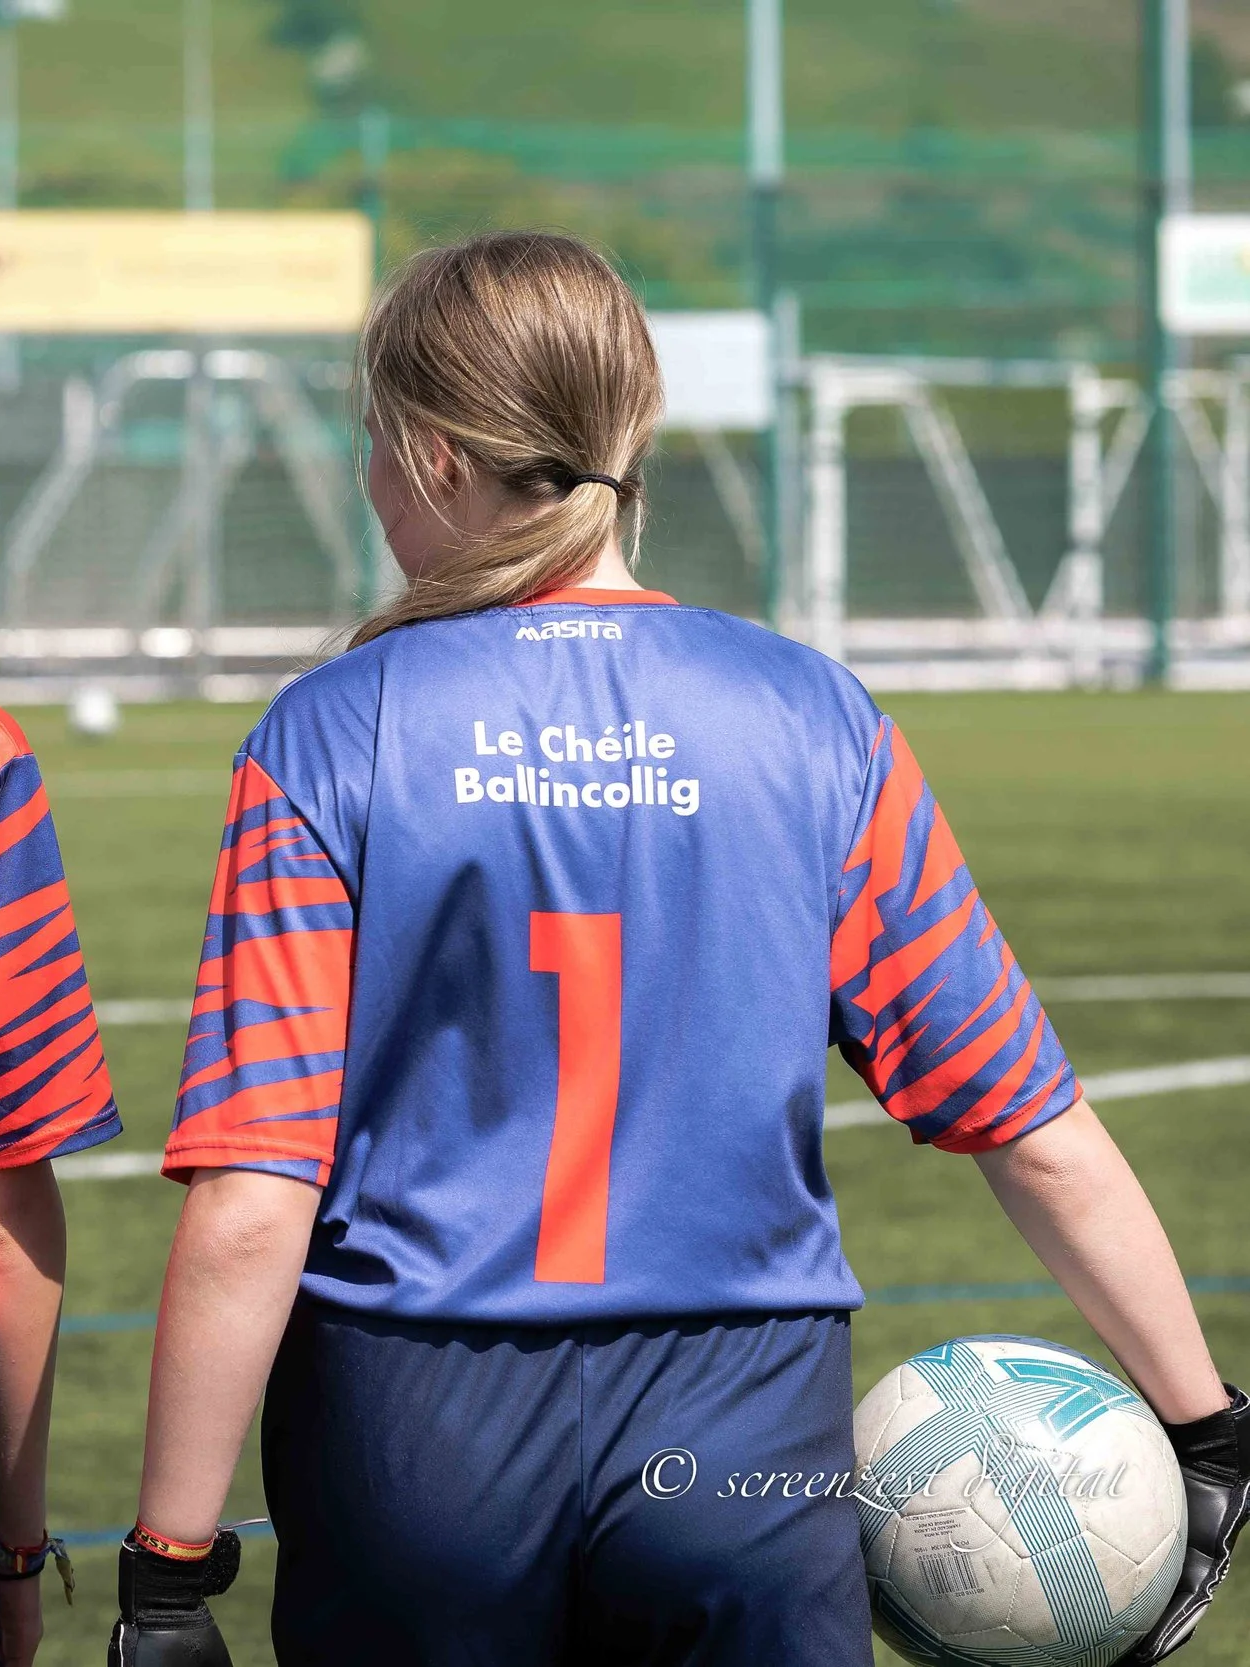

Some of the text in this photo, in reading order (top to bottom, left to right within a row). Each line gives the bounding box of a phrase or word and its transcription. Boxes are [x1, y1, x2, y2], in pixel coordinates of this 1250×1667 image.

[473, 720, 676, 762] Le Chéile
[454, 764, 700, 816] Ballincollig
[529, 911, 622, 1284] 1
